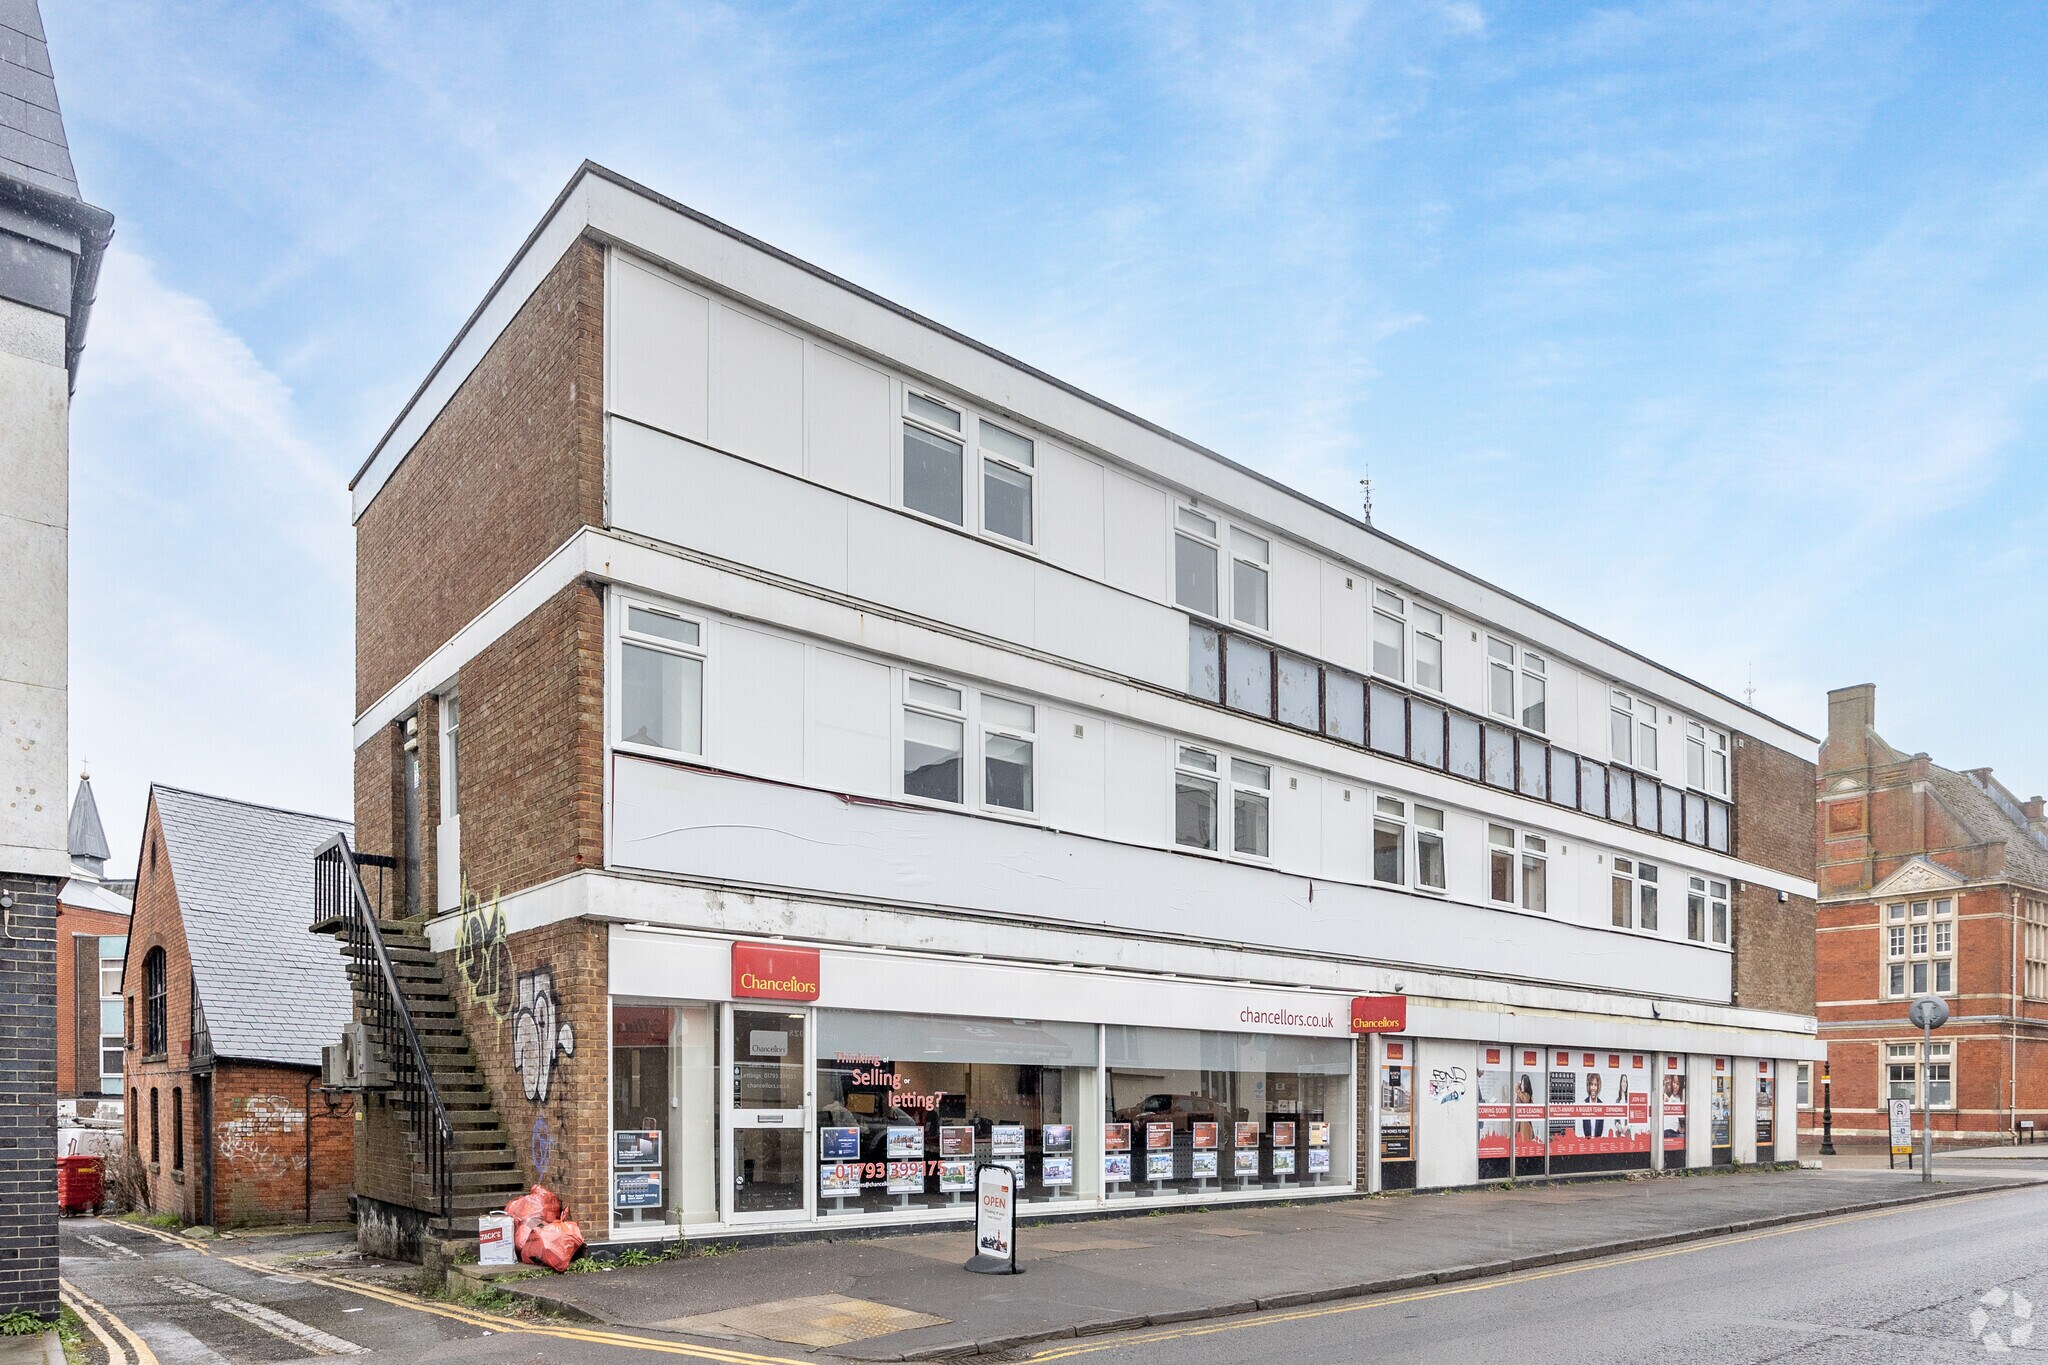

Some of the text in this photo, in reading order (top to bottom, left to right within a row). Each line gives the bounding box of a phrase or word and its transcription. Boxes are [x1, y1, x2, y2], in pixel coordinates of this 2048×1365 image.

[741, 973, 816, 993] Chancellors
[1240, 1006, 1334, 1028] chancellors.co.uk
[1353, 1016, 1400, 1029] Chancellors
[751, 1044, 786, 1053] Chancellors
[835, 1051, 881, 1067] Thinking
[852, 1068, 902, 1090] Selling
[888, 1090, 945, 1111] letting?
[835, 1160, 947, 1180] 01793 399175
[984, 1195, 1005, 1209] OPEN
[480, 1231, 501, 1241] JACK'S
